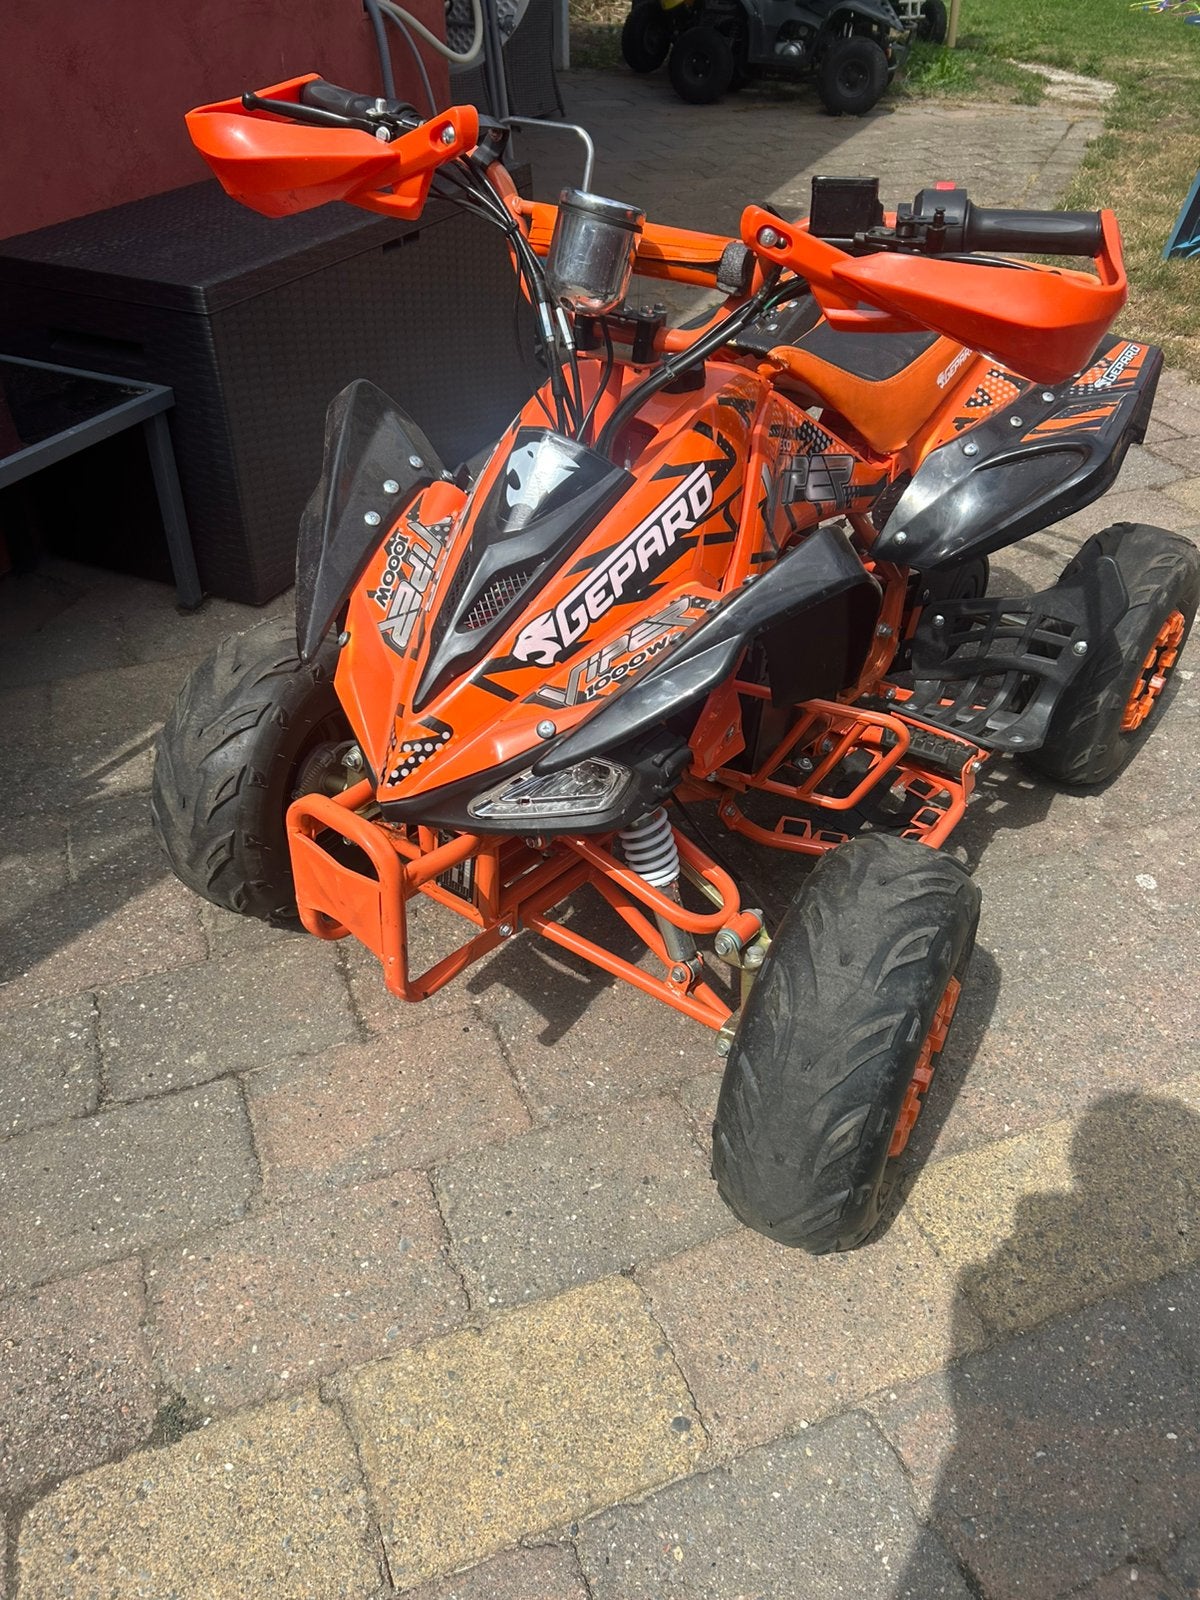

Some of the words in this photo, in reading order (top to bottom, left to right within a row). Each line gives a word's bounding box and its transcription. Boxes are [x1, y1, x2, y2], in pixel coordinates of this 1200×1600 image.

[944, 346, 973, 379] GEPAR
[1103, 342, 1141, 384] GEPARD
[374, 532, 411, 612] 1000W
[554, 461, 715, 648] GEPARD
[536, 597, 699, 706] VIPER
[584, 635, 670, 700] 1000W
